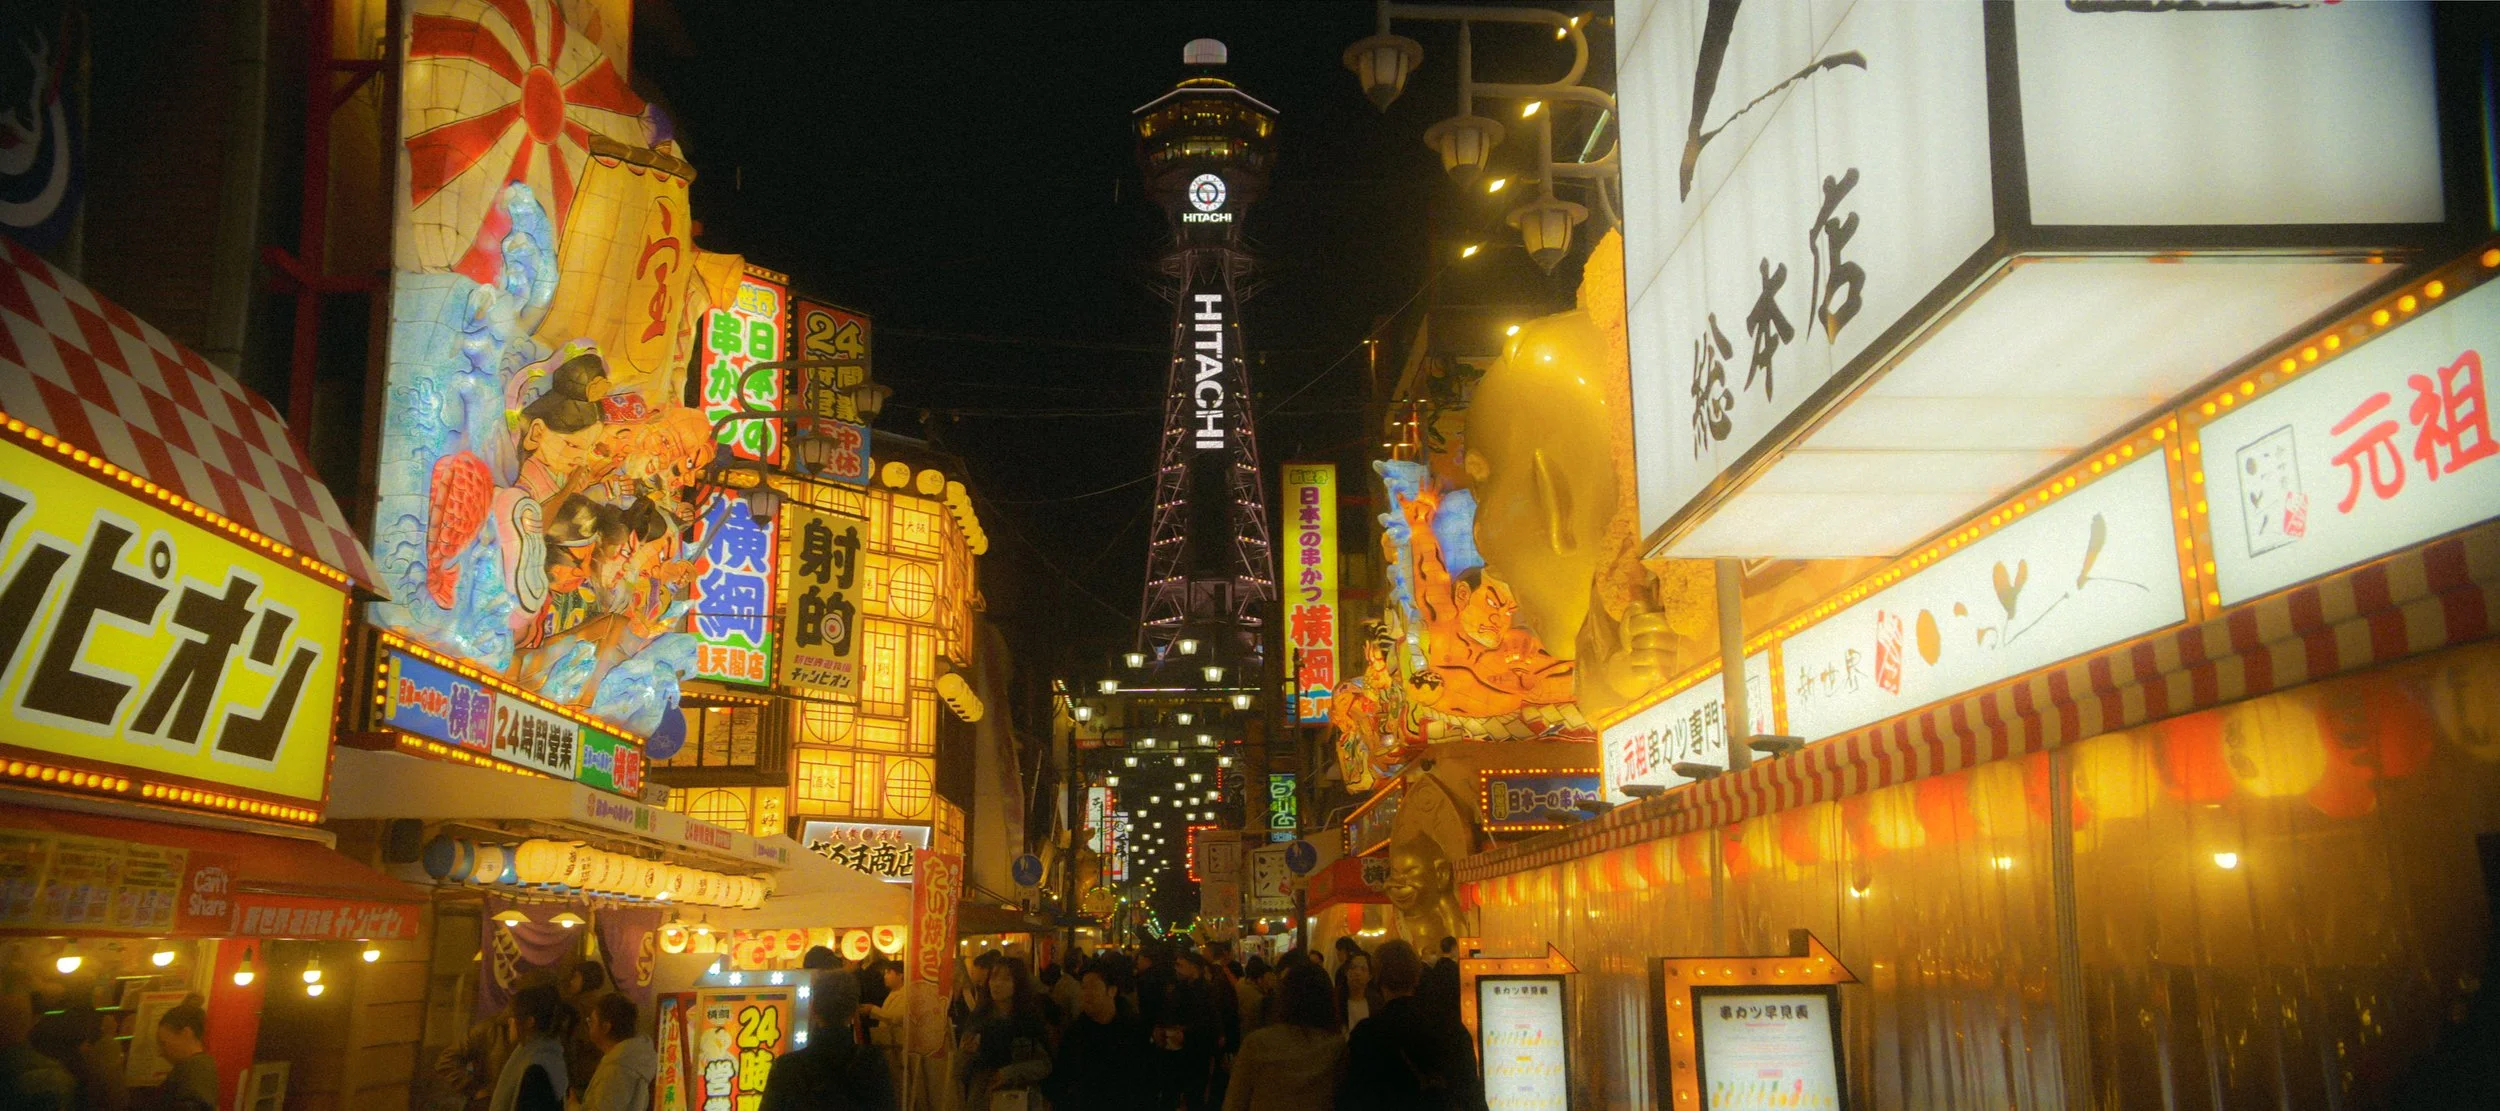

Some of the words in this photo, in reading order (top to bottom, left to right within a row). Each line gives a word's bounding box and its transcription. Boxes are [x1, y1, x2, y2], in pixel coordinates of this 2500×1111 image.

[1183, 213, 1232, 222] HITACHI
[806, 312, 865, 360] 24
[1194, 294, 1225, 449] HITACHI
[1691, 166, 1867, 462] 総本店
[709, 311, 742, 445] 串かつ
[2331, 349, 2499, 515] 元祖
[796, 517, 861, 657] 射的
[1298, 486, 1324, 602] 日本一の串かつ
[791, 667, 851, 688] チャンピオン
[1289, 604, 1334, 691] 横綱
[495, 705, 573, 772] 24時間営業
[1623, 699, 1729, 782] 元祖串カツ専門
[921, 856, 950, 983] たい焼き
